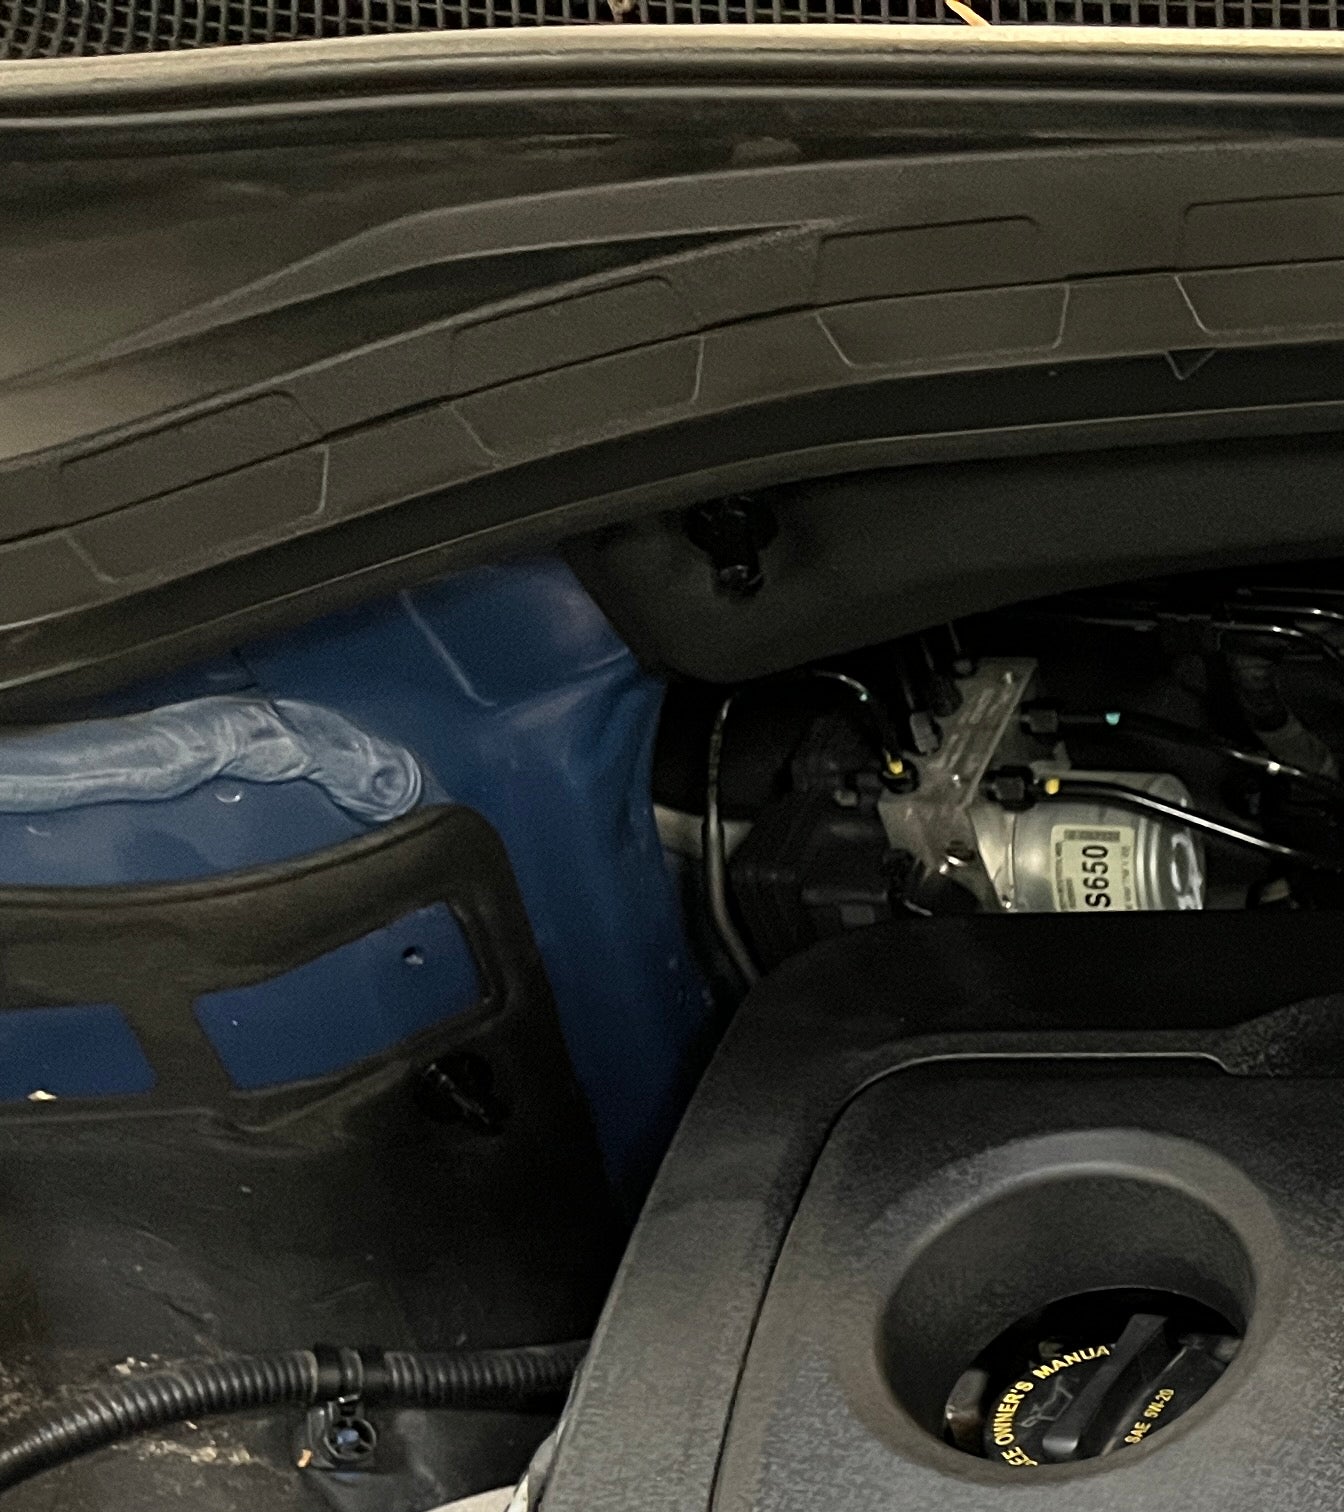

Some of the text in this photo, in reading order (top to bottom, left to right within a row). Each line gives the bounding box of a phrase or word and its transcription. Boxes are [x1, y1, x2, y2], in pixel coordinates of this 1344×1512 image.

[1079, 844, 1111, 909] S650
[992, 1380, 1034, 1447] OWNER'S
[1032, 1344, 1111, 1380] MANUA
[1123, 1420, 1152, 1445] SAE
